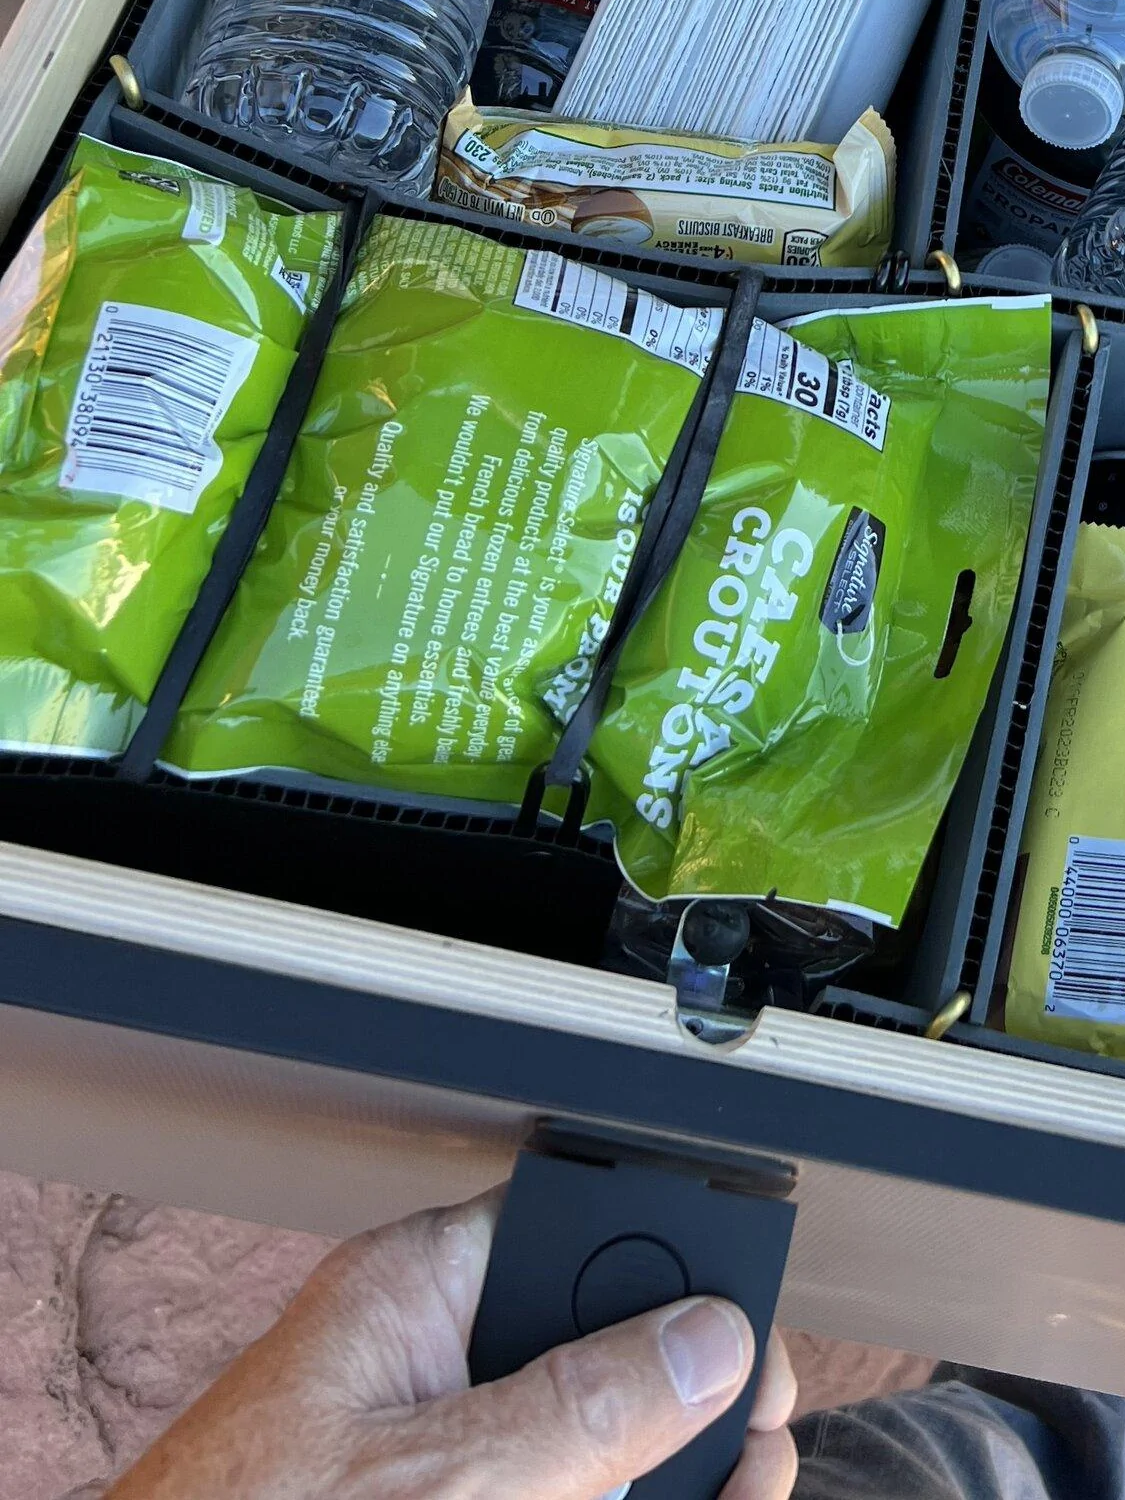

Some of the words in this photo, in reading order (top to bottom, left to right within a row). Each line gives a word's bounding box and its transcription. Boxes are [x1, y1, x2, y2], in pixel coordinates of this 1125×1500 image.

[644, 171, 655, 181] (2
[659, 171, 681, 182] pack
[685, 175, 690, 183] 1
[694, 175, 715, 184] size:
[719, 176, 752, 189] Serving
[758, 182, 784, 193] Facts
[457, 189, 469, 205] OZ
[488, 201, 504, 216] WT
[787, 187, 828, 201] Nutrition
[505, 204, 522, 221] NET
[677, 218, 719, 238] BISCUITS
[288, 238, 298, 254] LLC
[721, 223, 773, 244] BREAKFAST
[790, 235, 808, 244] PACK
[556, 300, 570, 316] 0%
[573, 305, 587, 321] 0%
[589, 310, 603, 325] 0%
[605, 315, 618, 331] 0%
[643, 328, 659, 349] 0%
[84, 331, 113, 385] 21130
[775, 352, 790, 371] Daily
[741, 370, 759, 390] 0%
[757, 374, 774, 394] 1%
[789, 370, 826, 409] 30
[834, 375, 857, 400] tbsp
[67, 390, 97, 449] 38094
[465, 390, 490, 418] We
[518, 408, 547, 447] from
[366, 418, 403, 480] Quality
[536, 425, 571, 479] quality
[468, 452, 502, 509] French
[496, 446, 535, 519] delicious
[554, 435, 600, 513] Signature
[331, 484, 348, 501] or
[355, 481, 382, 515] and
[431, 488, 458, 520] put
[614, 488, 646, 526] IS
[316, 501, 340, 537] your
[515, 479, 555, 553] products
[422, 520, 447, 552] our
[451, 510, 484, 563] bread
[479, 518, 514, 575] frozen
[298, 539, 331, 595] money
[322, 516, 372, 623] satisfaction
[444, 563, 466, 584] to
[510, 554, 531, 576] at
[594, 527, 642, 603] OUR
[825, 522, 885, 616] Signature
[390, 551, 440, 641] Signature
[500, 577, 525, 610] the
[537, 574, 556, 594] is
[285, 596, 318, 646] back.
[428, 585, 461, 637] home
[458, 576, 497, 646] entrees
[520, 592, 552, 634] your
[487, 610, 517, 653] best
[687, 528, 813, 768] CAESA
[388, 641, 412, 666] on
[449, 645, 476, 680] and
[636, 507, 771, 829] CROUTONS
[402, 638, 448, 729] essentials.
[475, 653, 506, 701] value
[366, 668, 411, 738] anything
[435, 682, 469, 735] freshly
[501, 716, 521, 734] of
[1068, 836, 1078, 844] 0
[1057, 865, 1078, 919] 44000
[1048, 926, 1069, 980] 06370
[1044, 1004, 1054, 1012] 2
